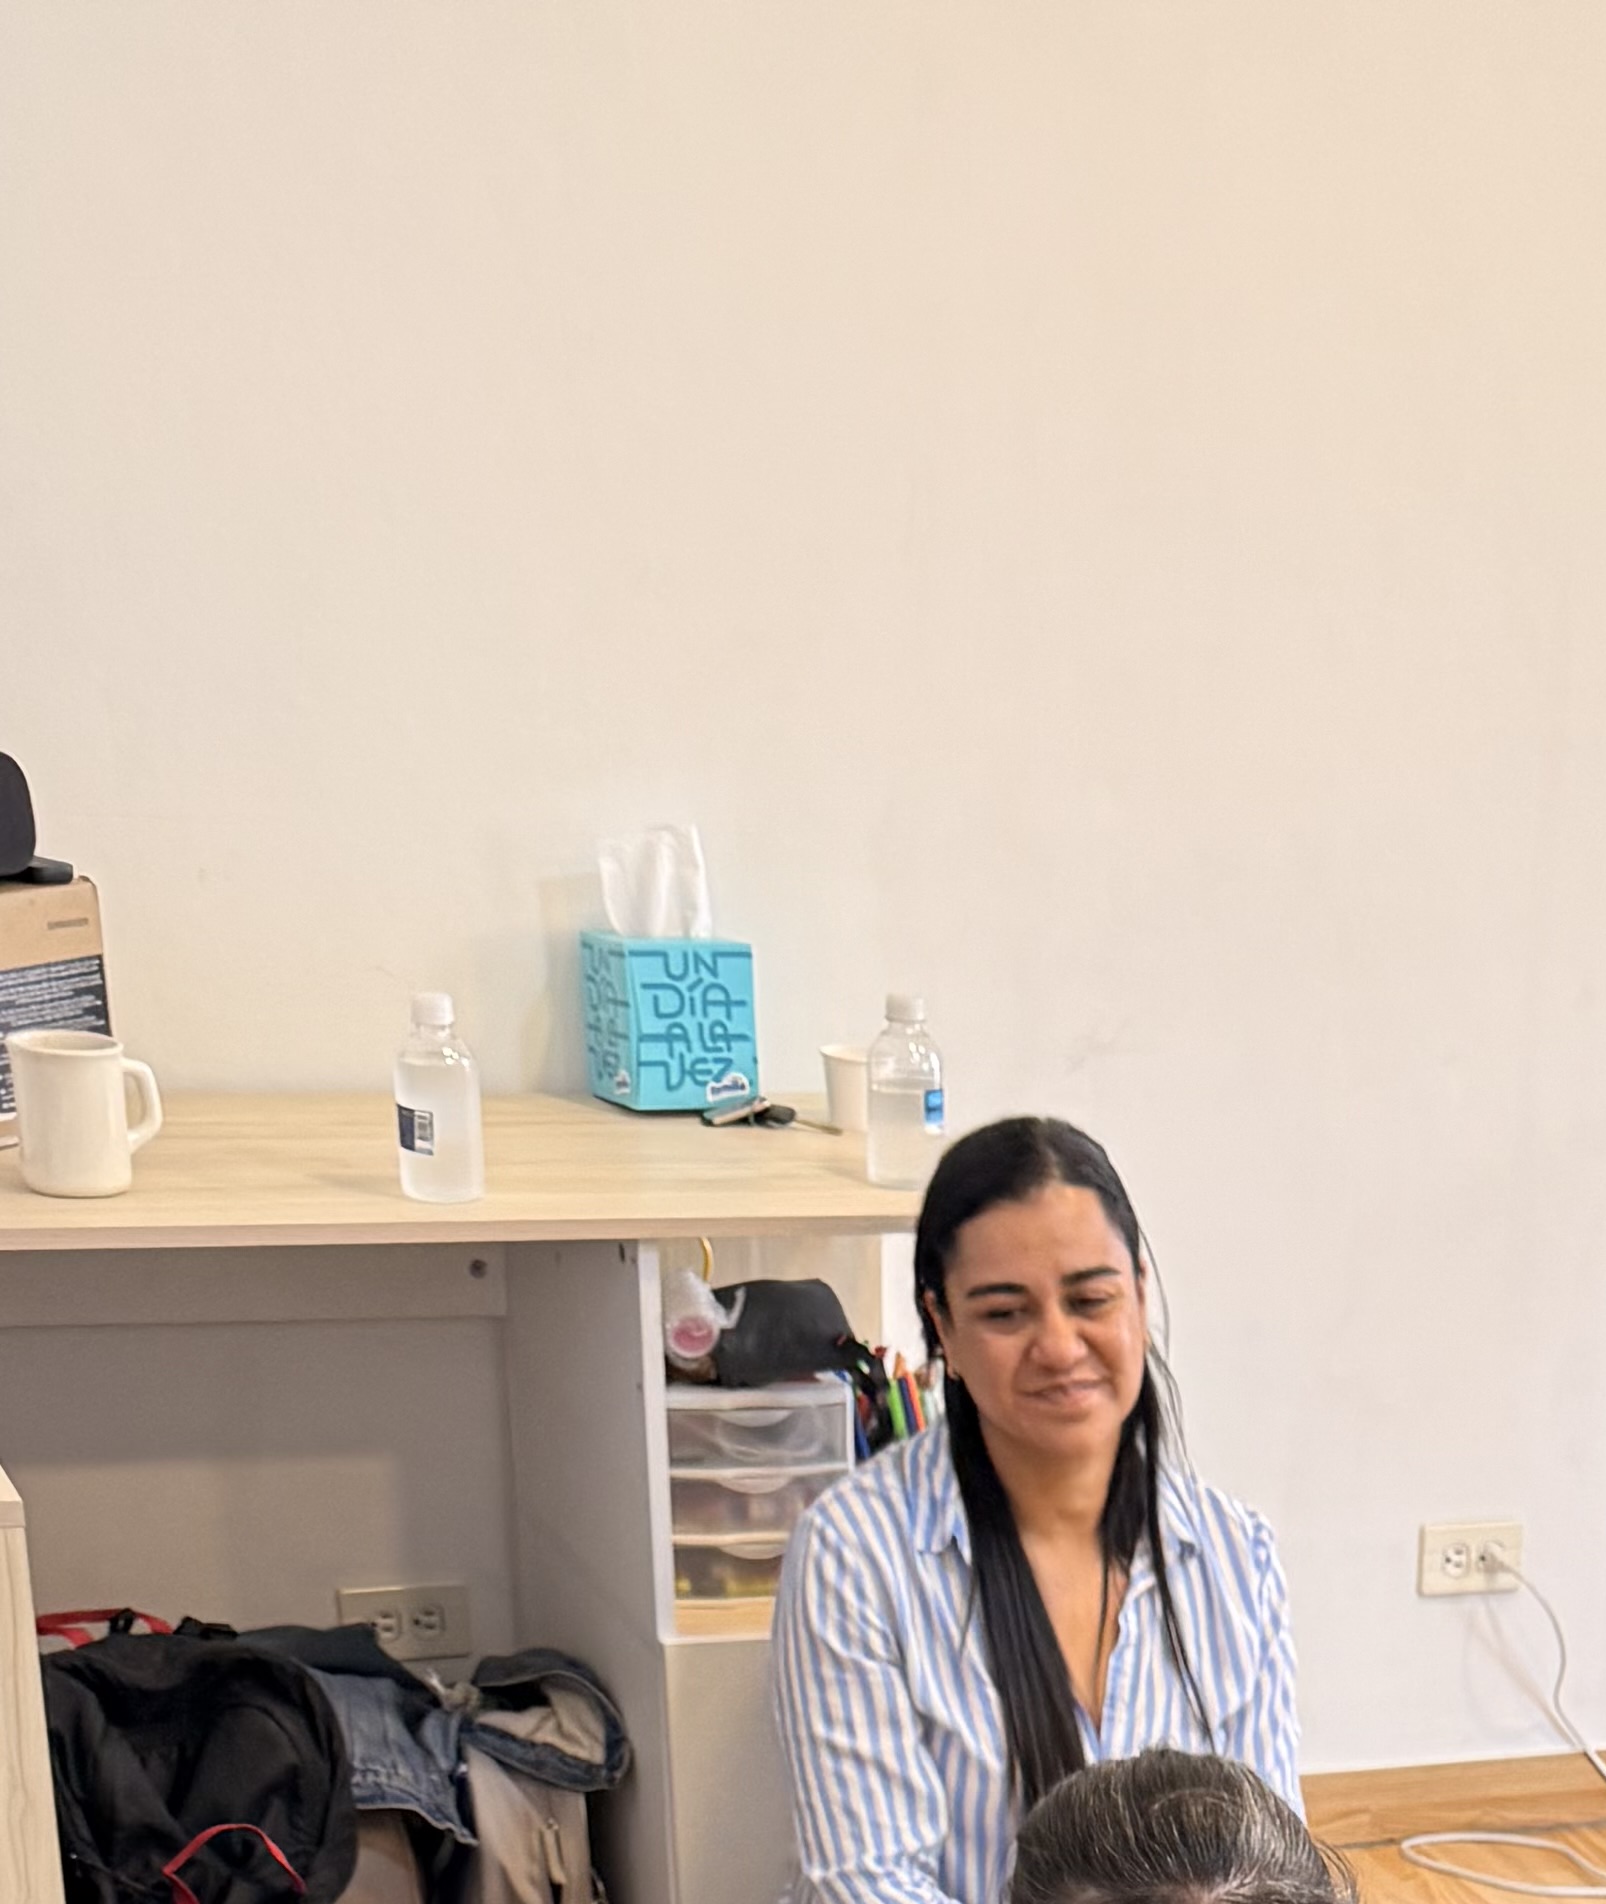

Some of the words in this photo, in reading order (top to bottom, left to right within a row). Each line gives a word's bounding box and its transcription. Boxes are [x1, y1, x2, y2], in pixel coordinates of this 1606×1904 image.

[628, 950, 752, 981] UN
[640, 978, 747, 1021] DÍA
[697, 1020, 749, 1052] LA
